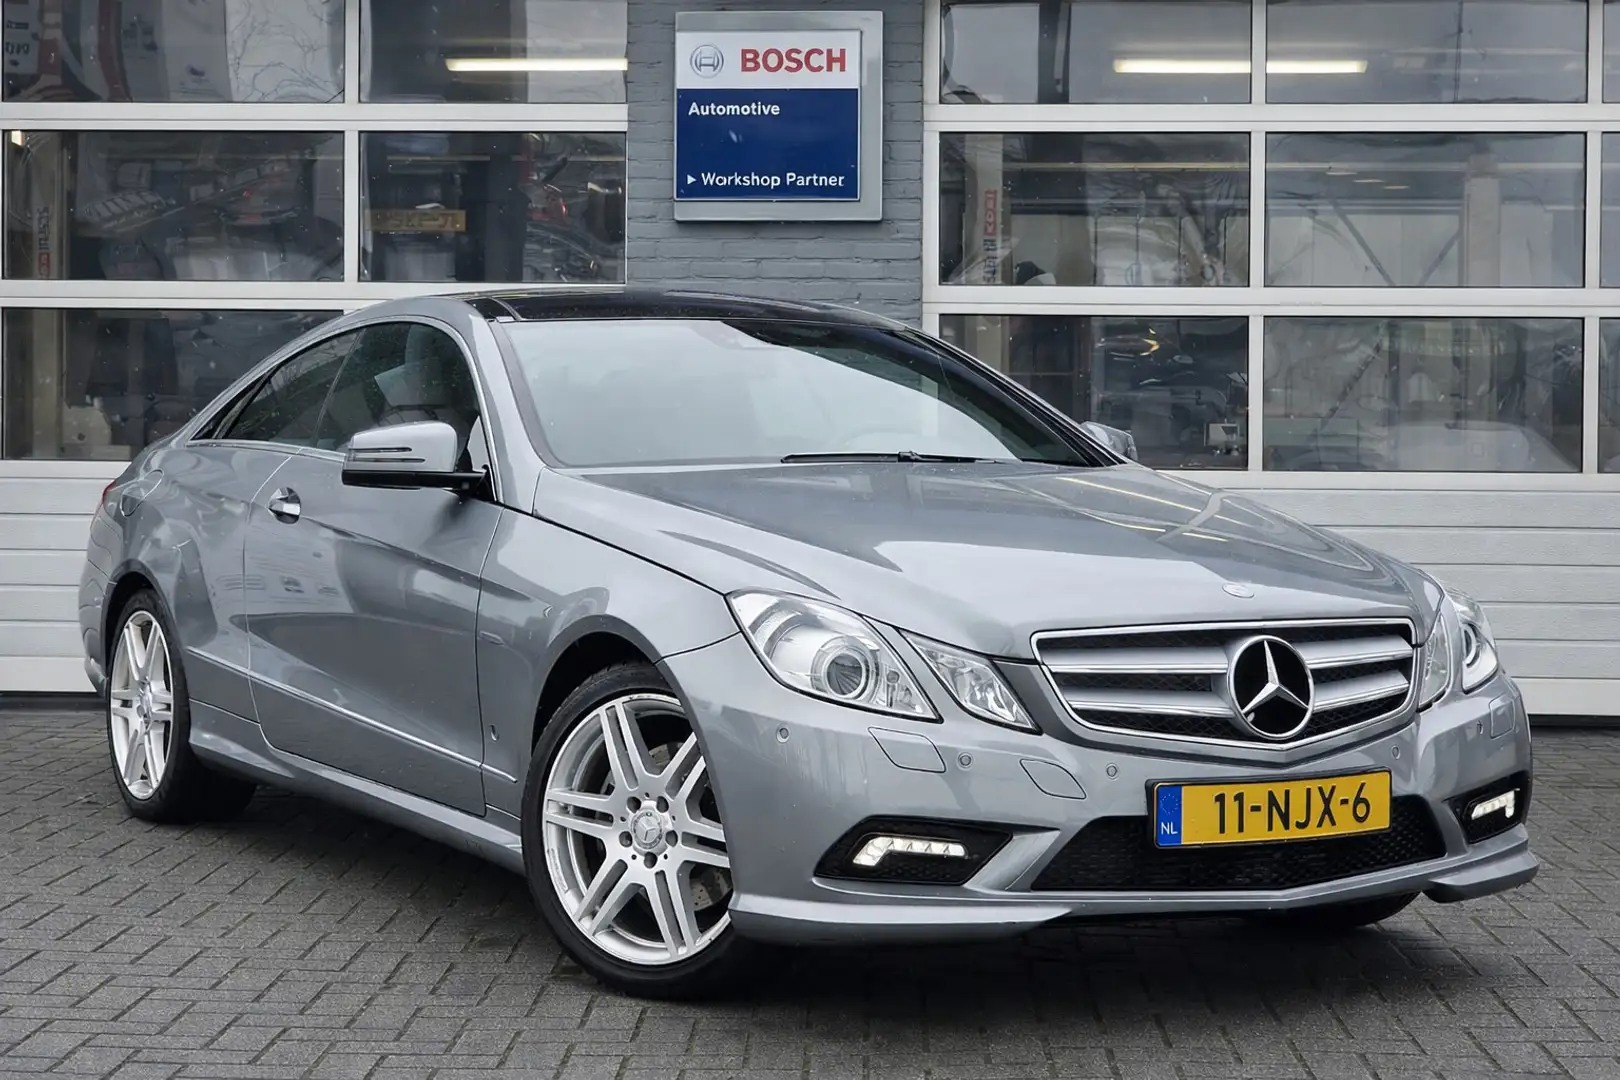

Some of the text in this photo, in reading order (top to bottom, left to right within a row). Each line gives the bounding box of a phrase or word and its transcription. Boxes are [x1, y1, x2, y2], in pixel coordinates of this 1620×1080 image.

[740, 48, 846, 72] BOSCH
[688, 101, 780, 116] Automotive
[701, 171, 845, 189] Workshop Partner
[1160, 782, 1371, 835] NL 11-NJX-6
